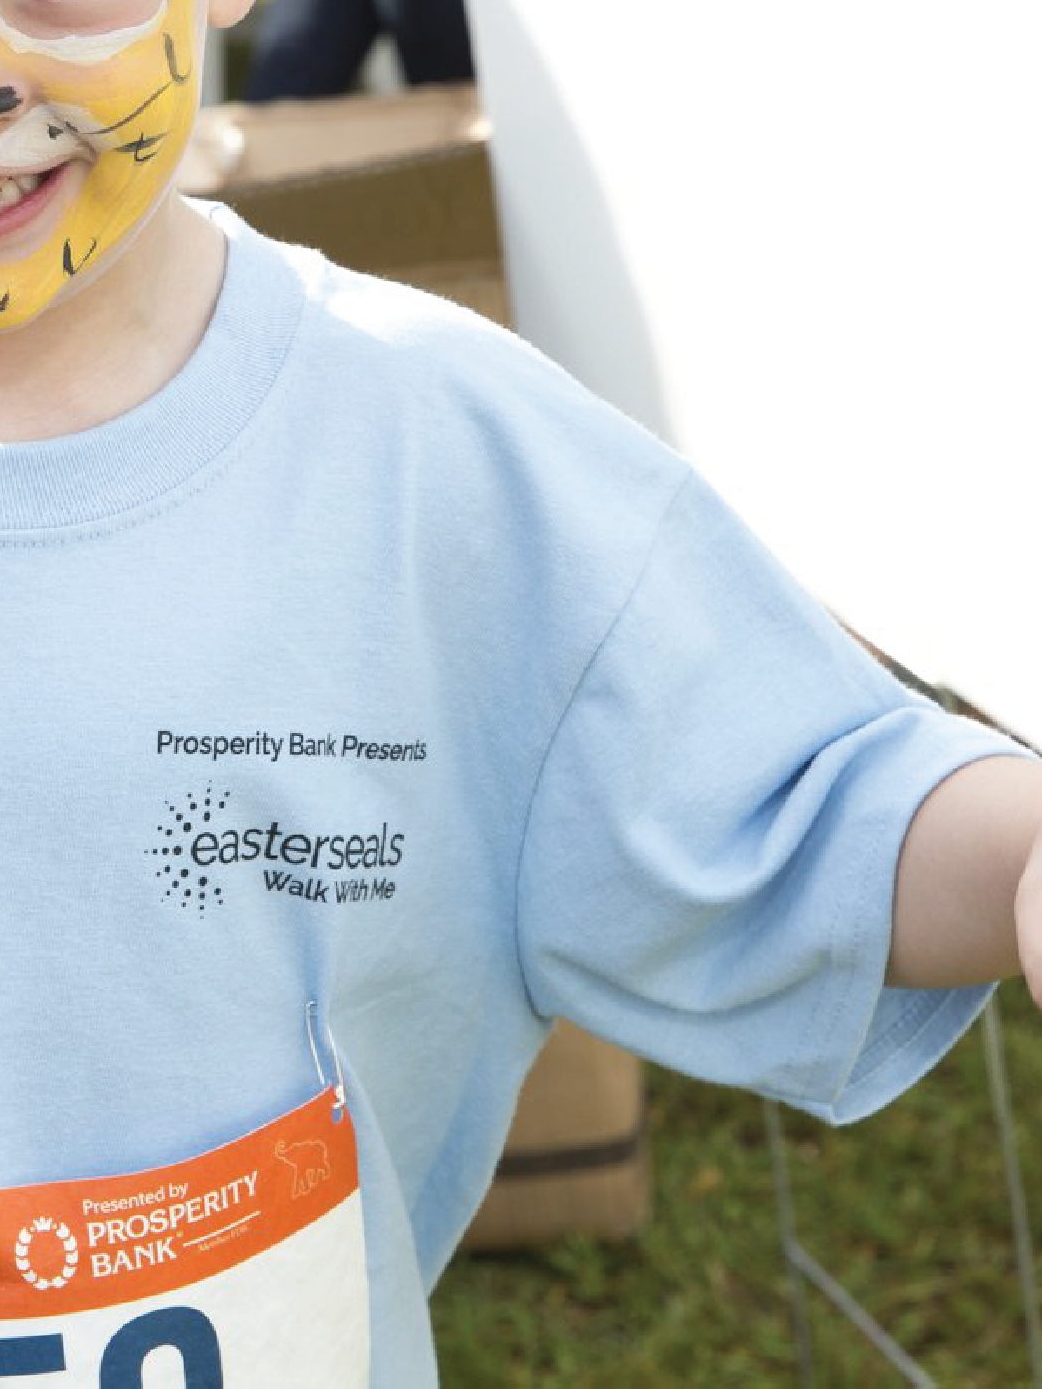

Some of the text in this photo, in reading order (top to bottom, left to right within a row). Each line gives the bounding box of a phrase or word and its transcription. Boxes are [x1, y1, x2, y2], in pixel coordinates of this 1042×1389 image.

[157, 731, 427, 762] Prosperity Bank Presents
[191, 822, 405, 870] easterseals
[263, 870, 395, 903] Walk With Me
[82, 1182, 189, 1215] Presented by
[86, 1169, 259, 1248] PROSPERITY
[91, 1236, 177, 1278] BANK
